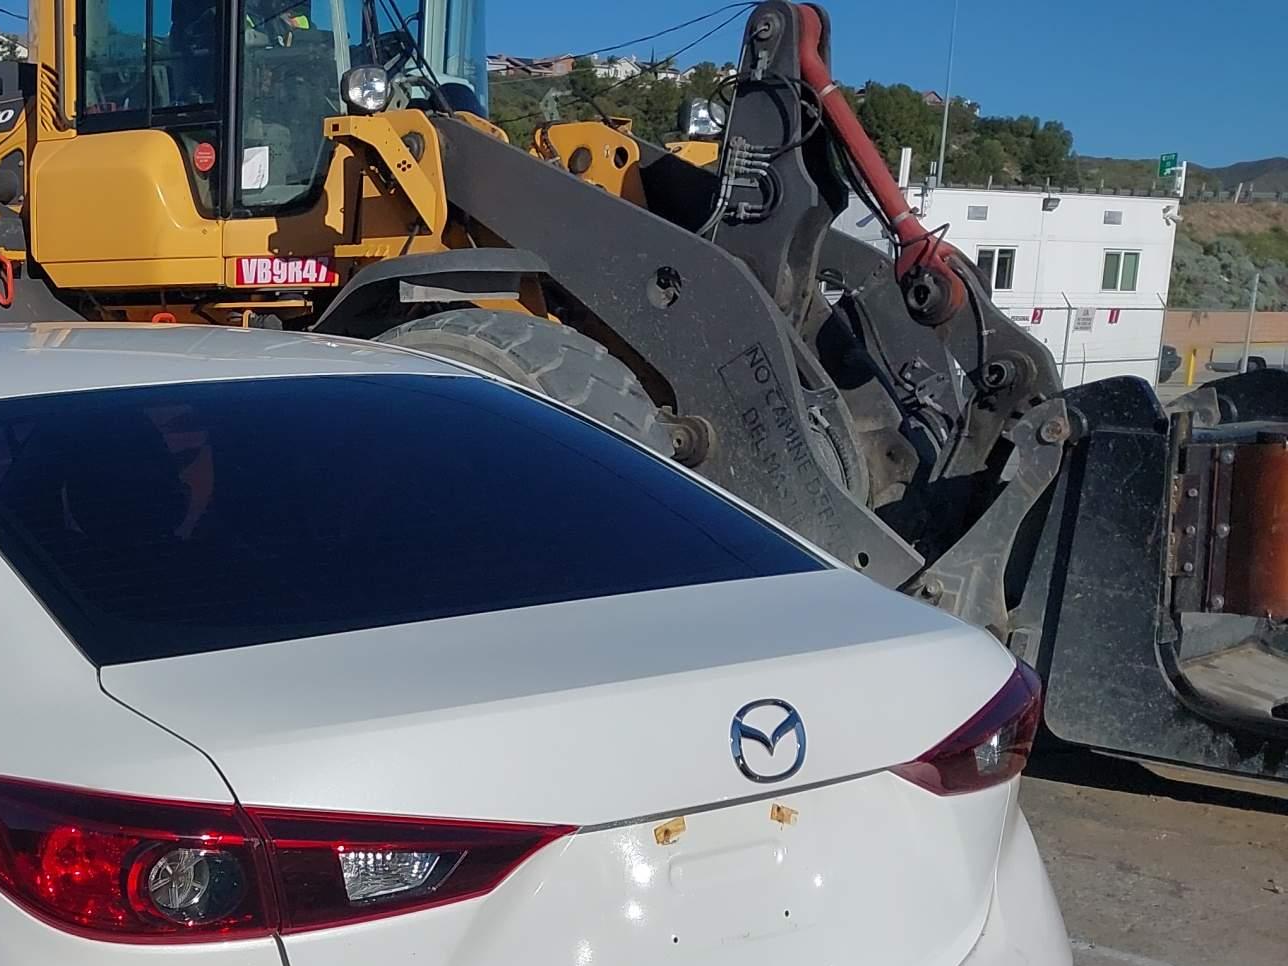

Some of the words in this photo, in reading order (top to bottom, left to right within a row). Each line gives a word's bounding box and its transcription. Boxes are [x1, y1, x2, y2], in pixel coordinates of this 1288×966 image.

[742, 407, 767, 451] DEL
[746, 347, 771, 384] NO
[765, 387, 813, 473] CAMINE
